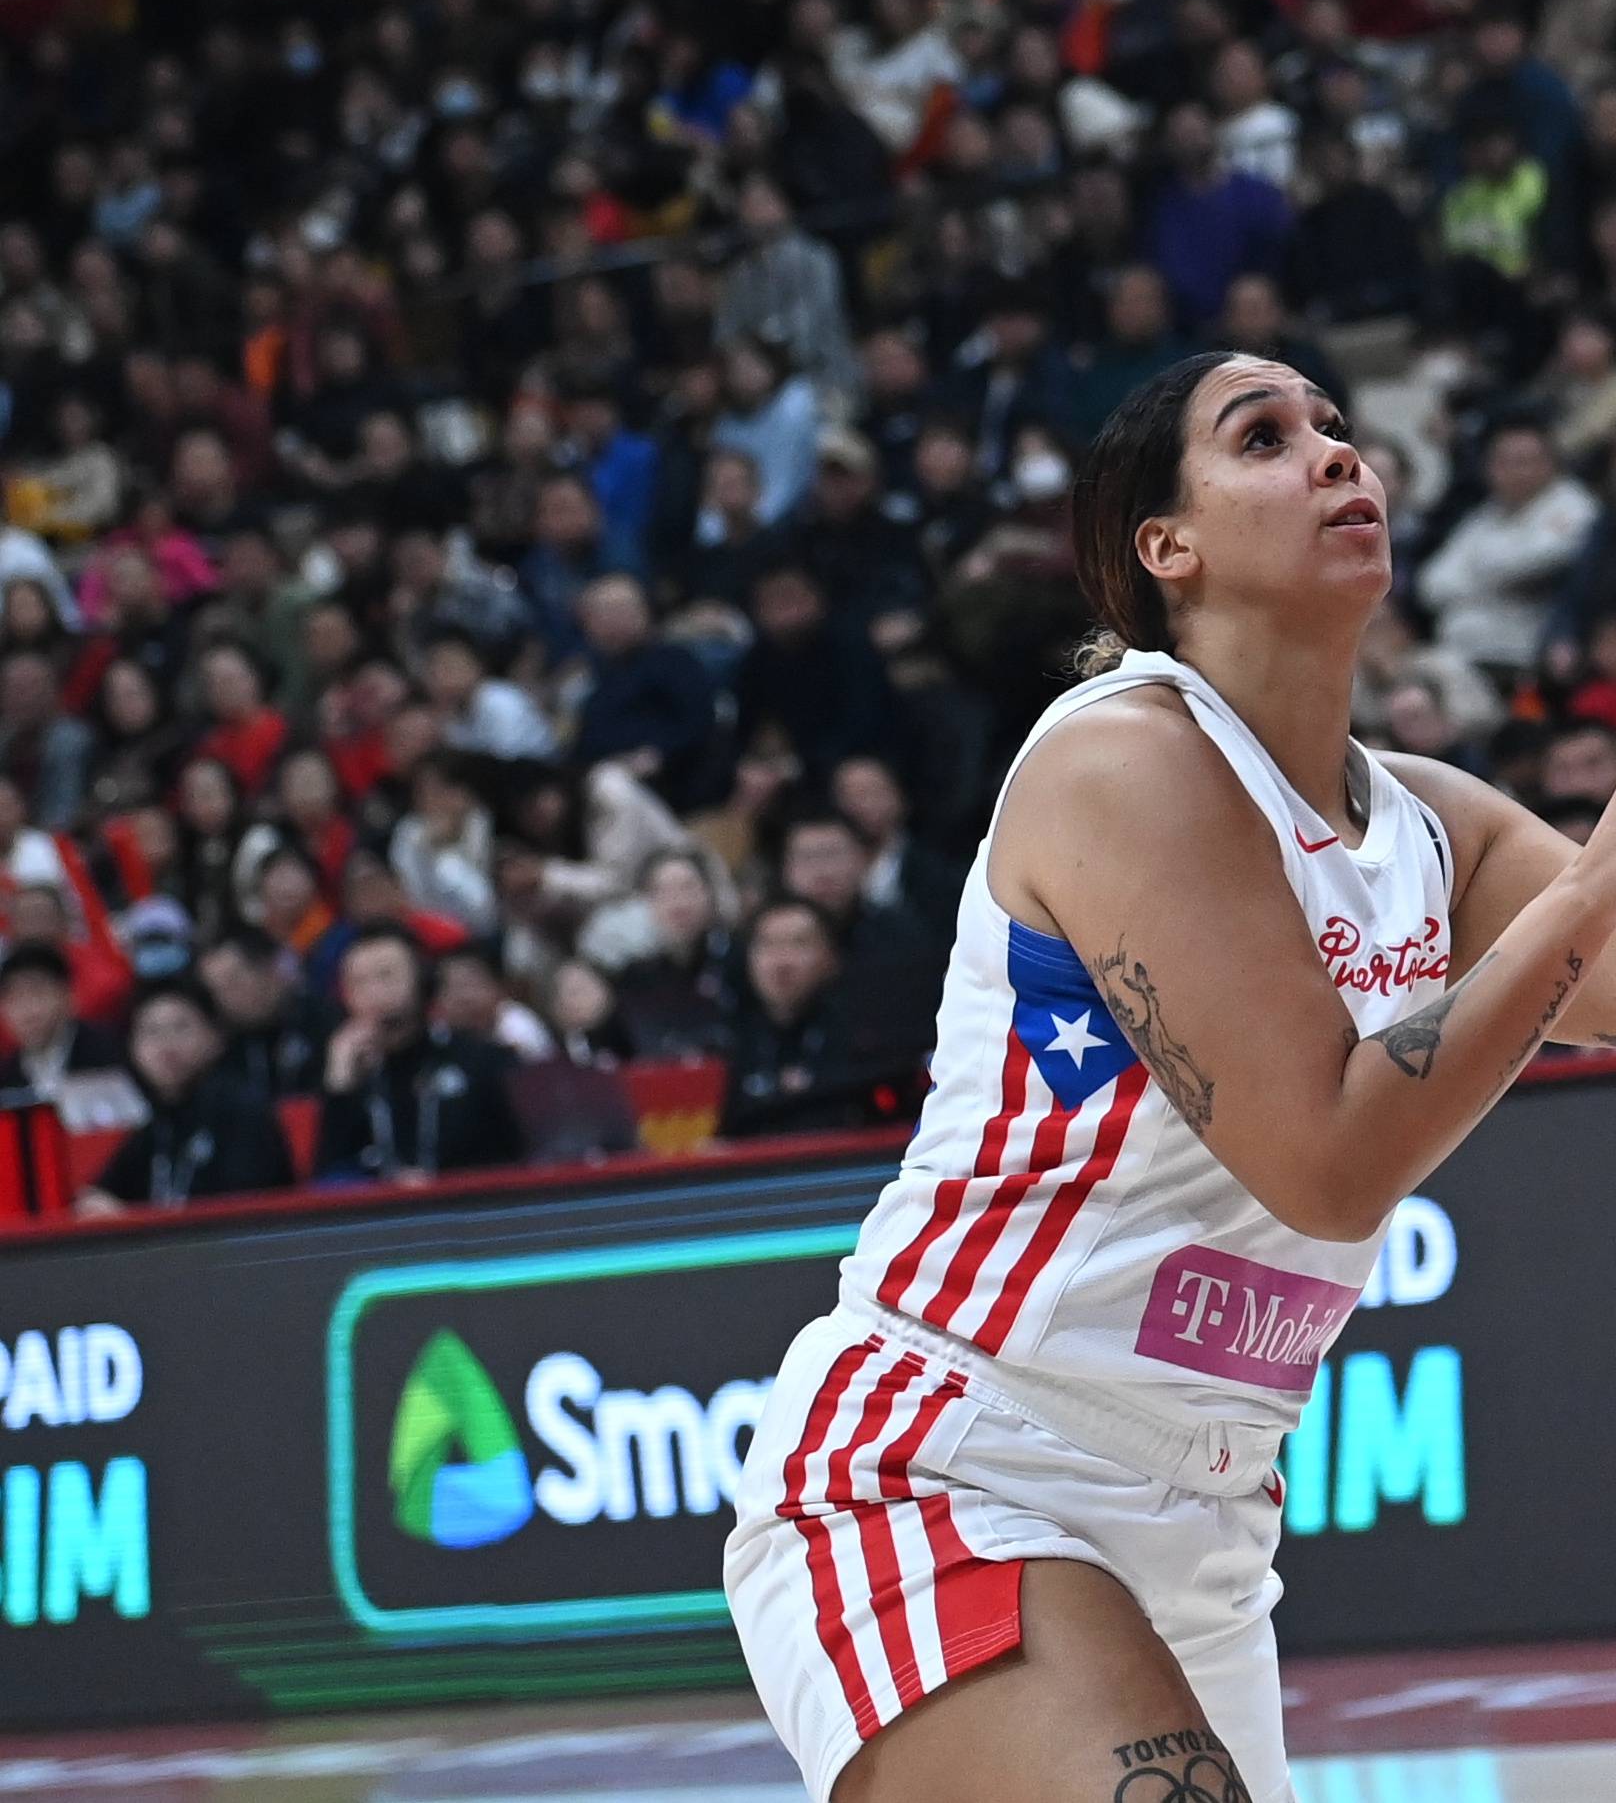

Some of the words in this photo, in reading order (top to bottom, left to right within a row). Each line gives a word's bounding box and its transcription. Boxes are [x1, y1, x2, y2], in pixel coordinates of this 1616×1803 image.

[1318, 916, 1421, 997] Puert
[0, 1456, 151, 1627] IM
[1112, 1729, 1200, 1768] TOKYO
